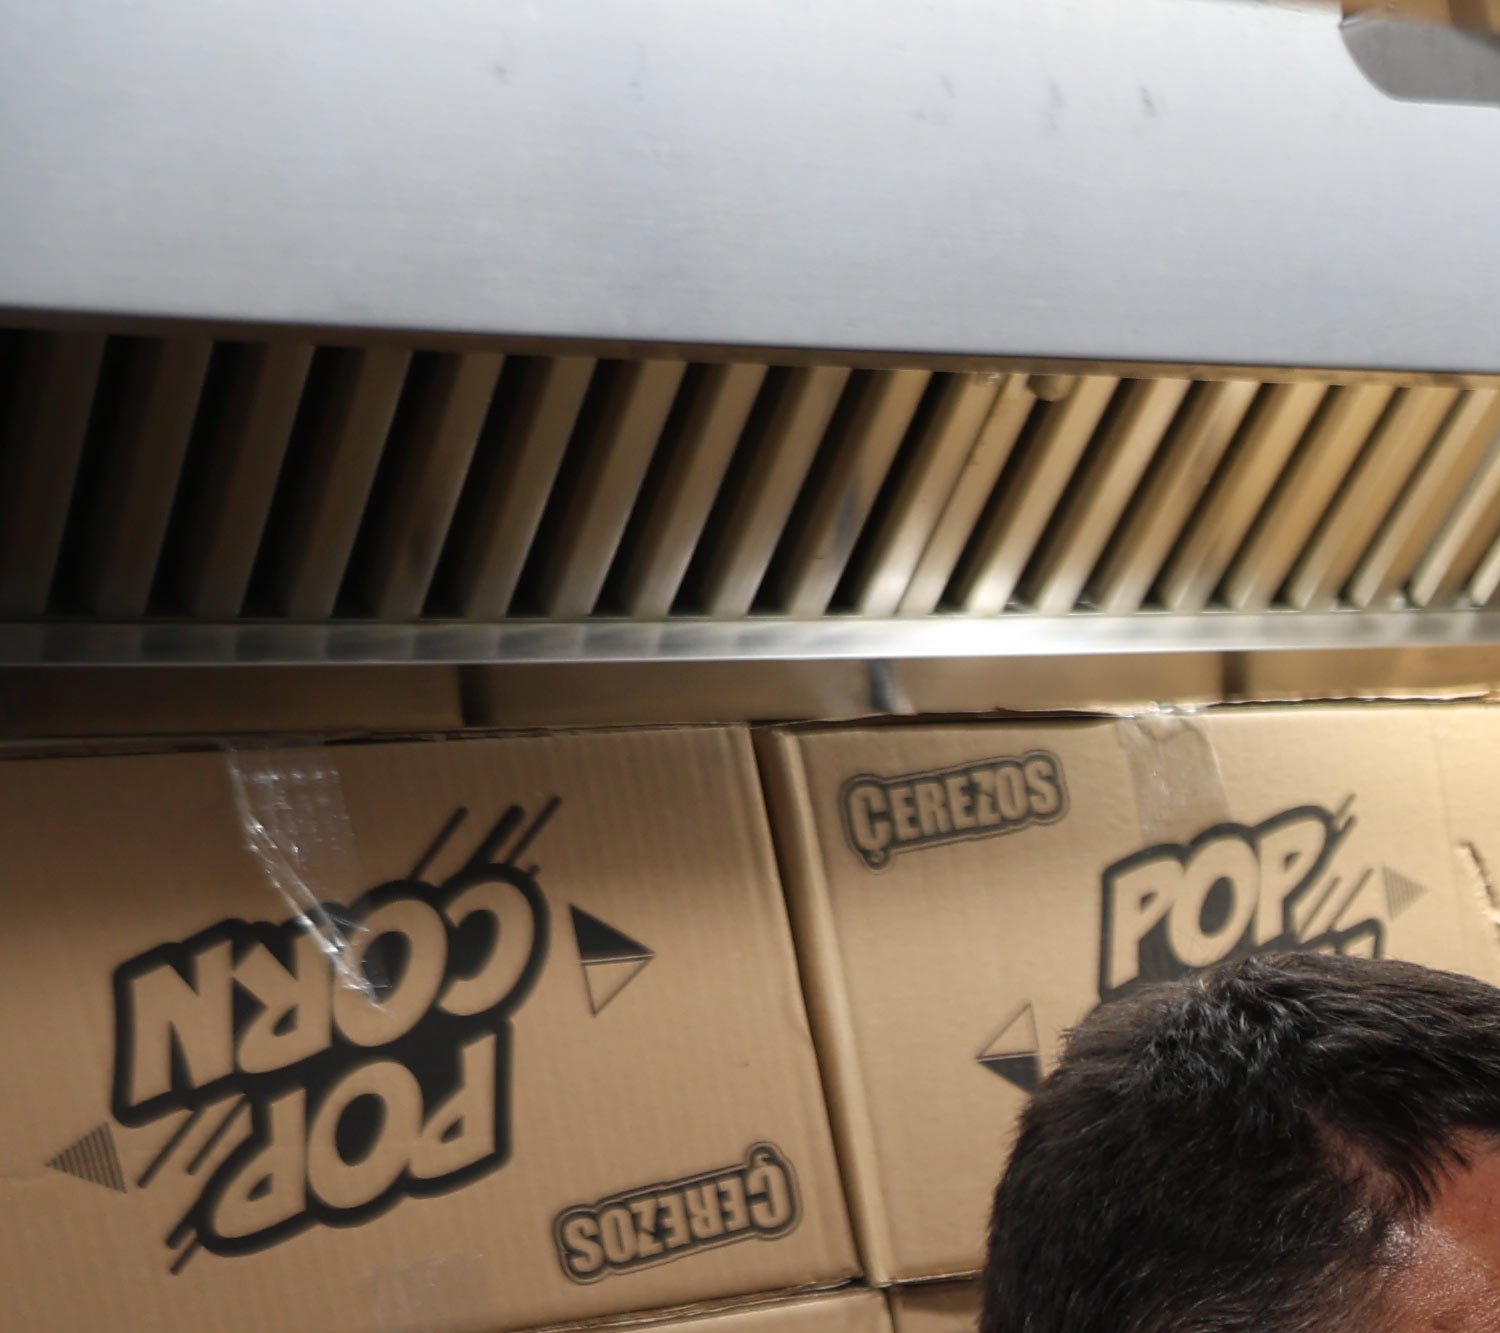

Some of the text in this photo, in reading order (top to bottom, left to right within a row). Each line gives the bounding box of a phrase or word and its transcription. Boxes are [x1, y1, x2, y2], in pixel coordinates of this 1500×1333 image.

[845, 756, 1063, 869] ÇEREZOS
[1104, 808, 1332, 994] POP
[118, 868, 547, 1118] CORN
[205, 1028, 508, 1248] POP
[560, 1147, 796, 1281] ÇEREZOS
